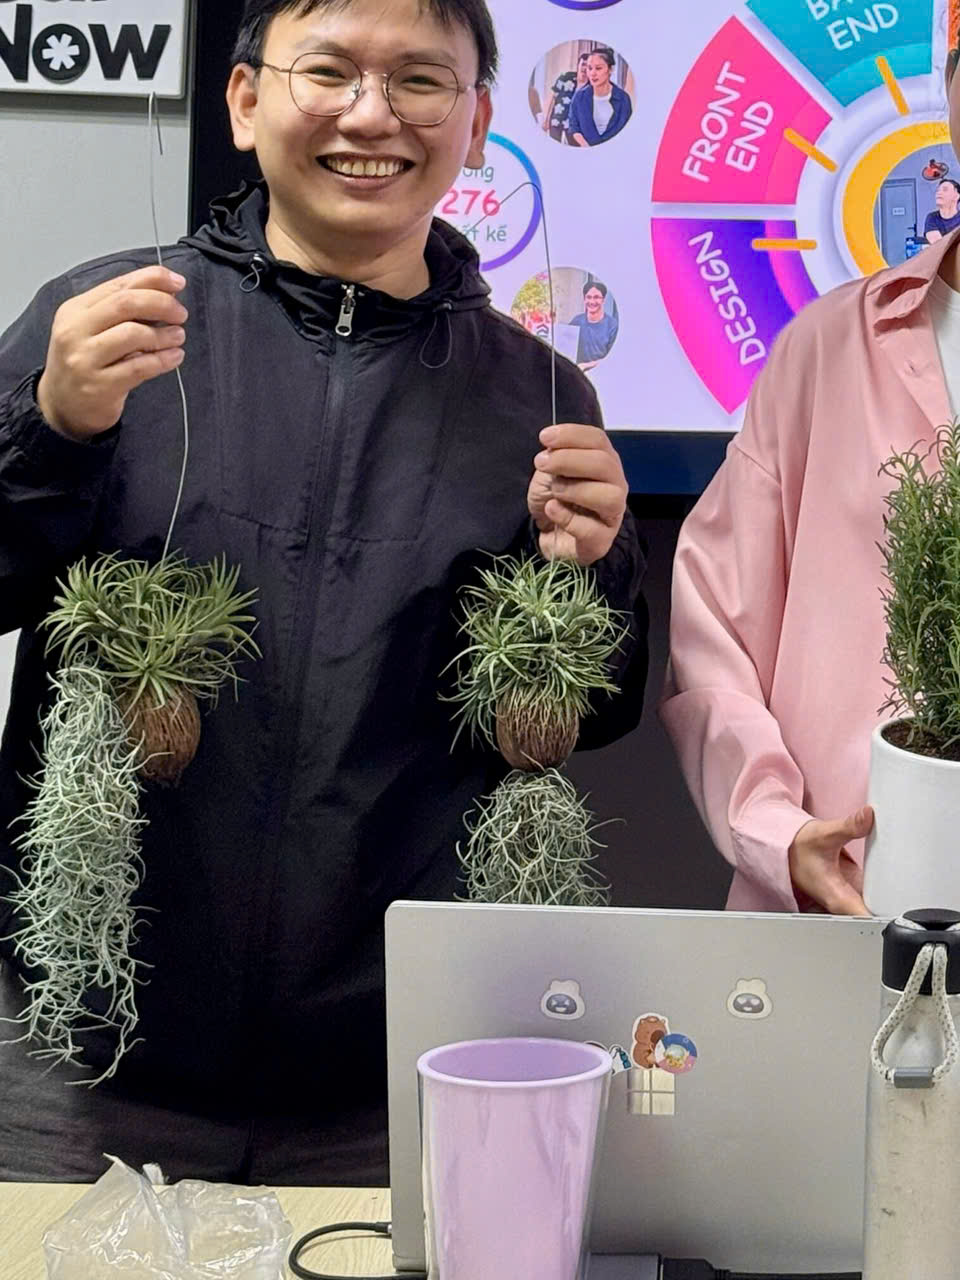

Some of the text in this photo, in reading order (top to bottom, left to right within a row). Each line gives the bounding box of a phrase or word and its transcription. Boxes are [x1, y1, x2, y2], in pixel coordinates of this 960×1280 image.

[827, 3, 899, 51] END
[681, 60, 747, 183] FRONT
[725, 100, 774, 172] END
[441, 189, 501, 217] 276
[688, 231, 767, 366] DESIGN
